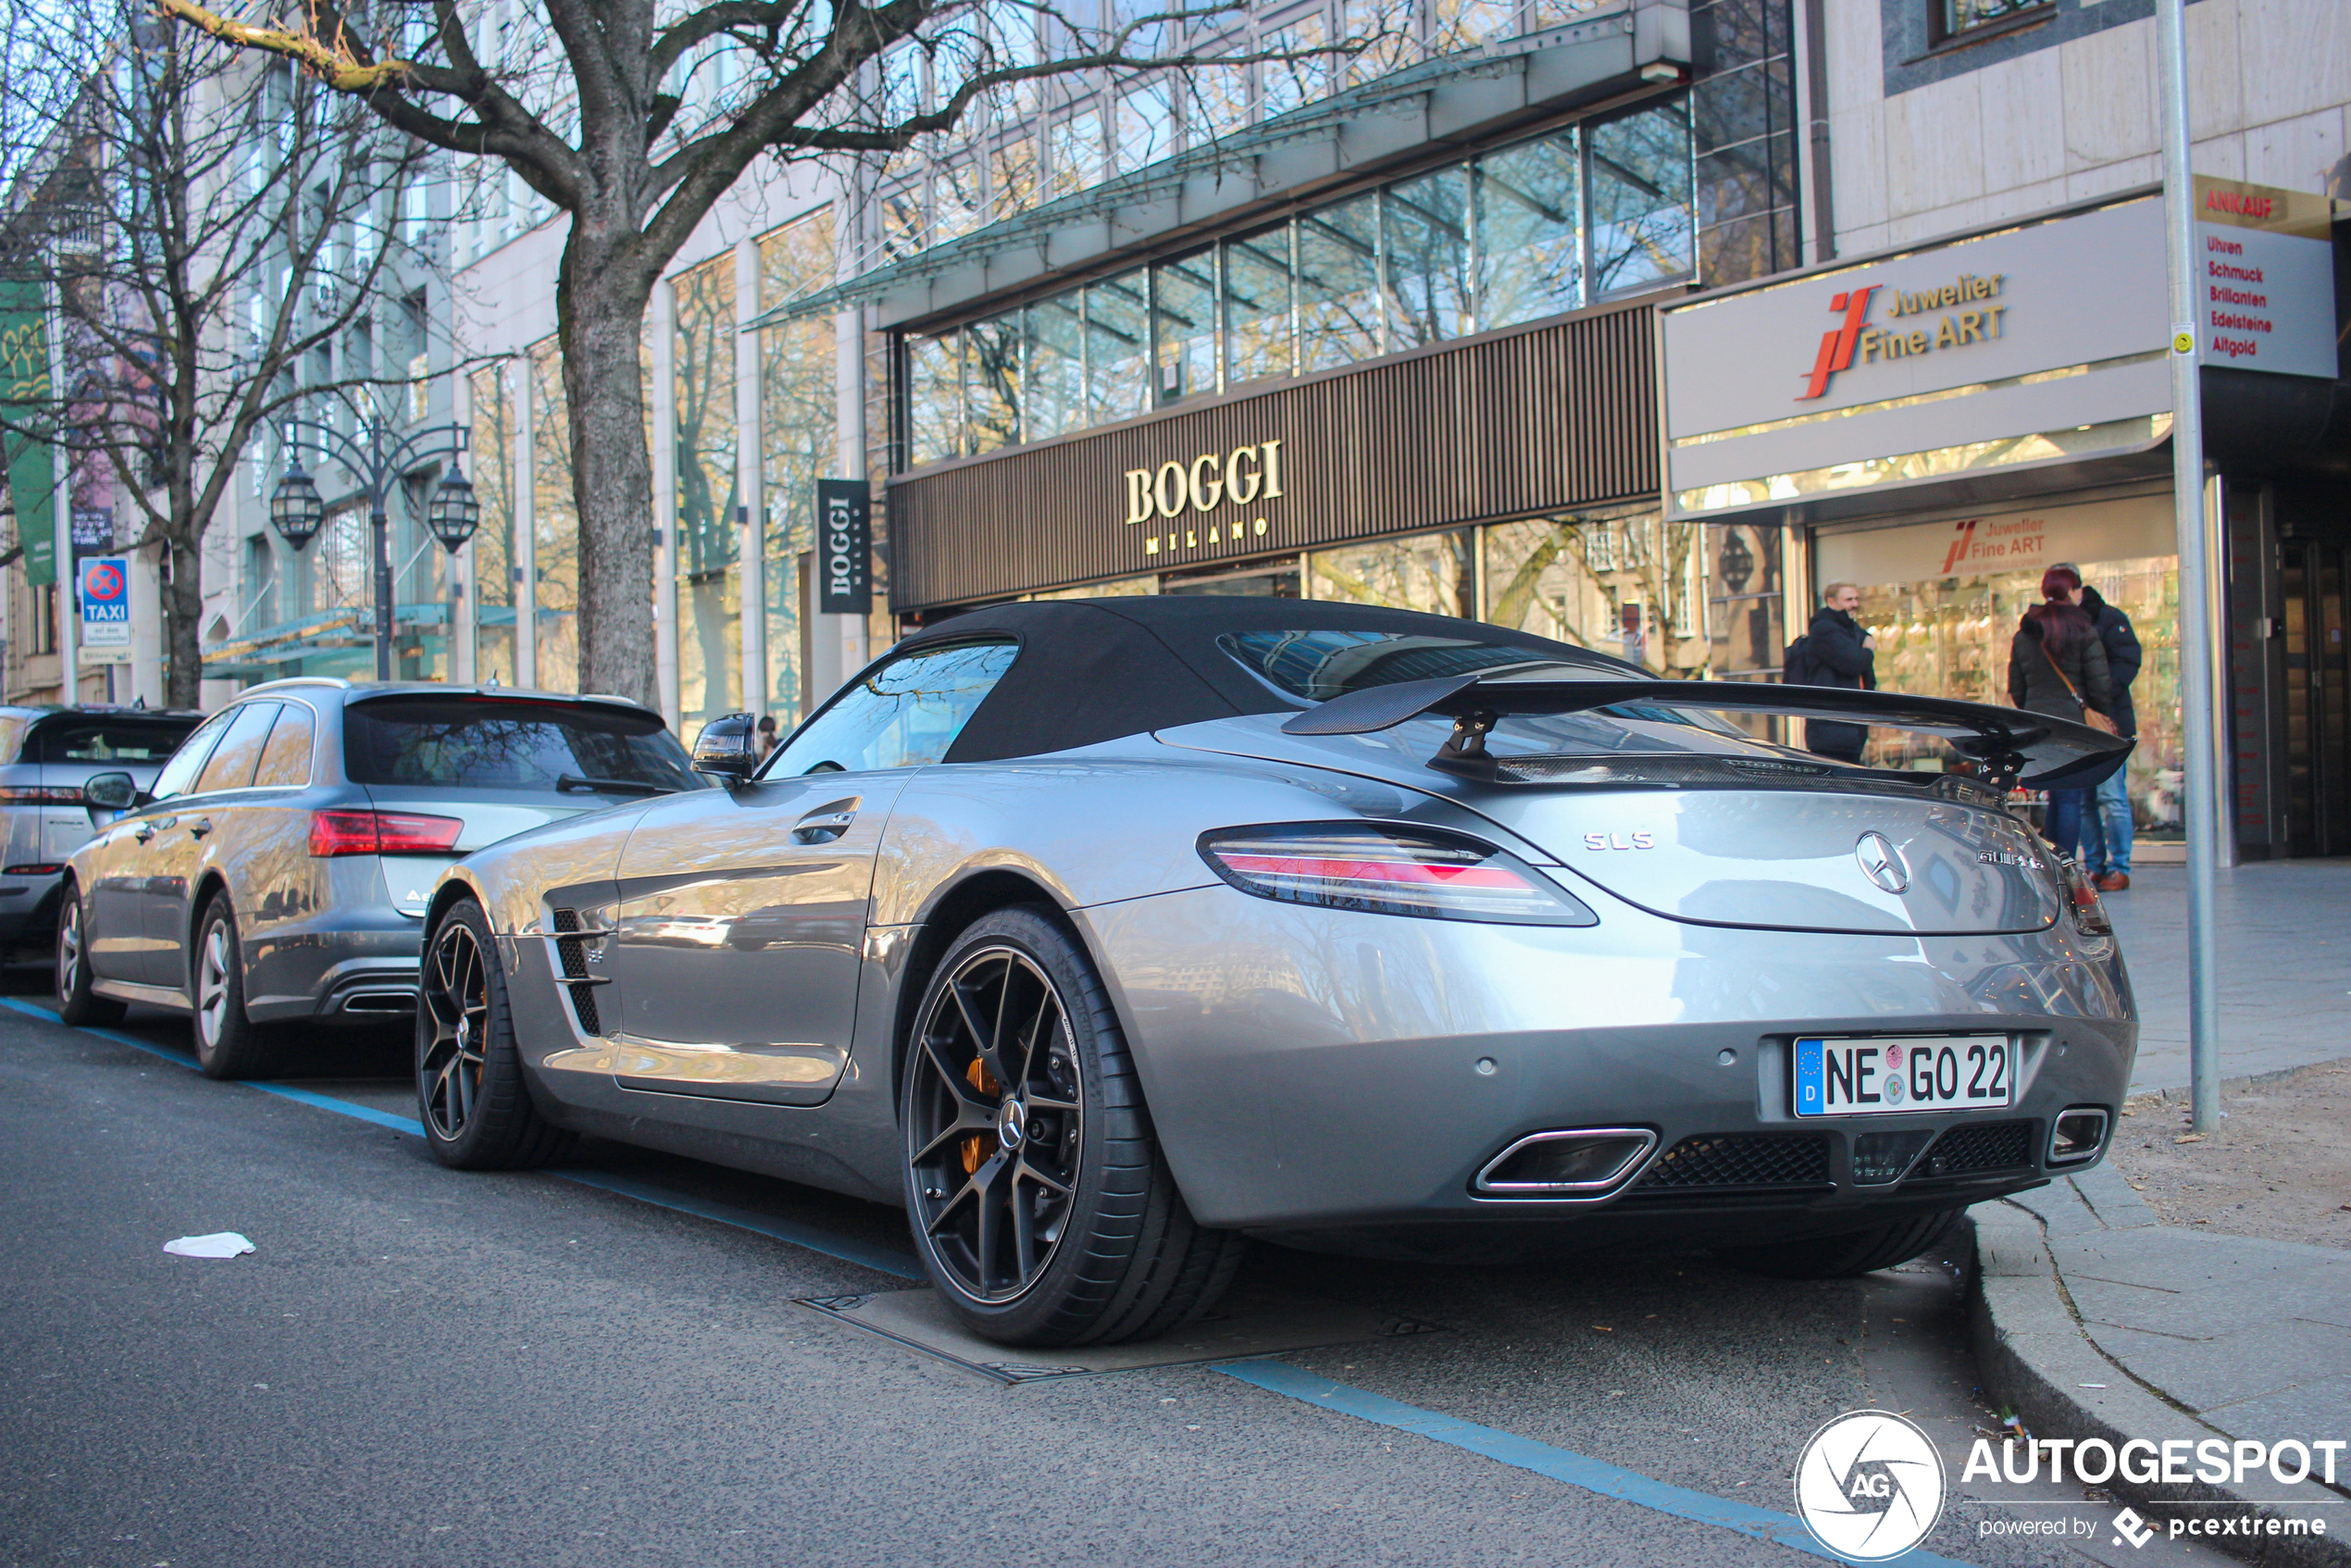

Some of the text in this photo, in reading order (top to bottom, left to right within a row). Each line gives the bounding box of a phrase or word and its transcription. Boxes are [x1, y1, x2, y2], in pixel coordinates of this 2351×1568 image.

[2207, 189, 2273, 218] ANKAUF
[2207, 236, 2244, 255] Uhren
[2208, 261, 2264, 283] Schmuck
[1886, 273, 2002, 317] Juwelier
[2209, 285, 2268, 307] Brillanten
[2210, 310, 2273, 333] Edelsteine
[1860, 305, 2004, 364] Fine ART
[2212, 336, 2257, 357] Altgold
[1125, 439, 1284, 525] BOGGI
[1145, 516, 1268, 555] MILANO
[1985, 518, 2045, 538] Juwelier
[828, 497, 852, 595] BOGGI
[852, 507, 862, 585] MILANO
[1972, 535, 2046, 559] Fine ART
[86, 604, 126, 620] TAXI
[1584, 831, 1655, 851] SLS
[1805, 1044, 2007, 1105] D NE GO 22
